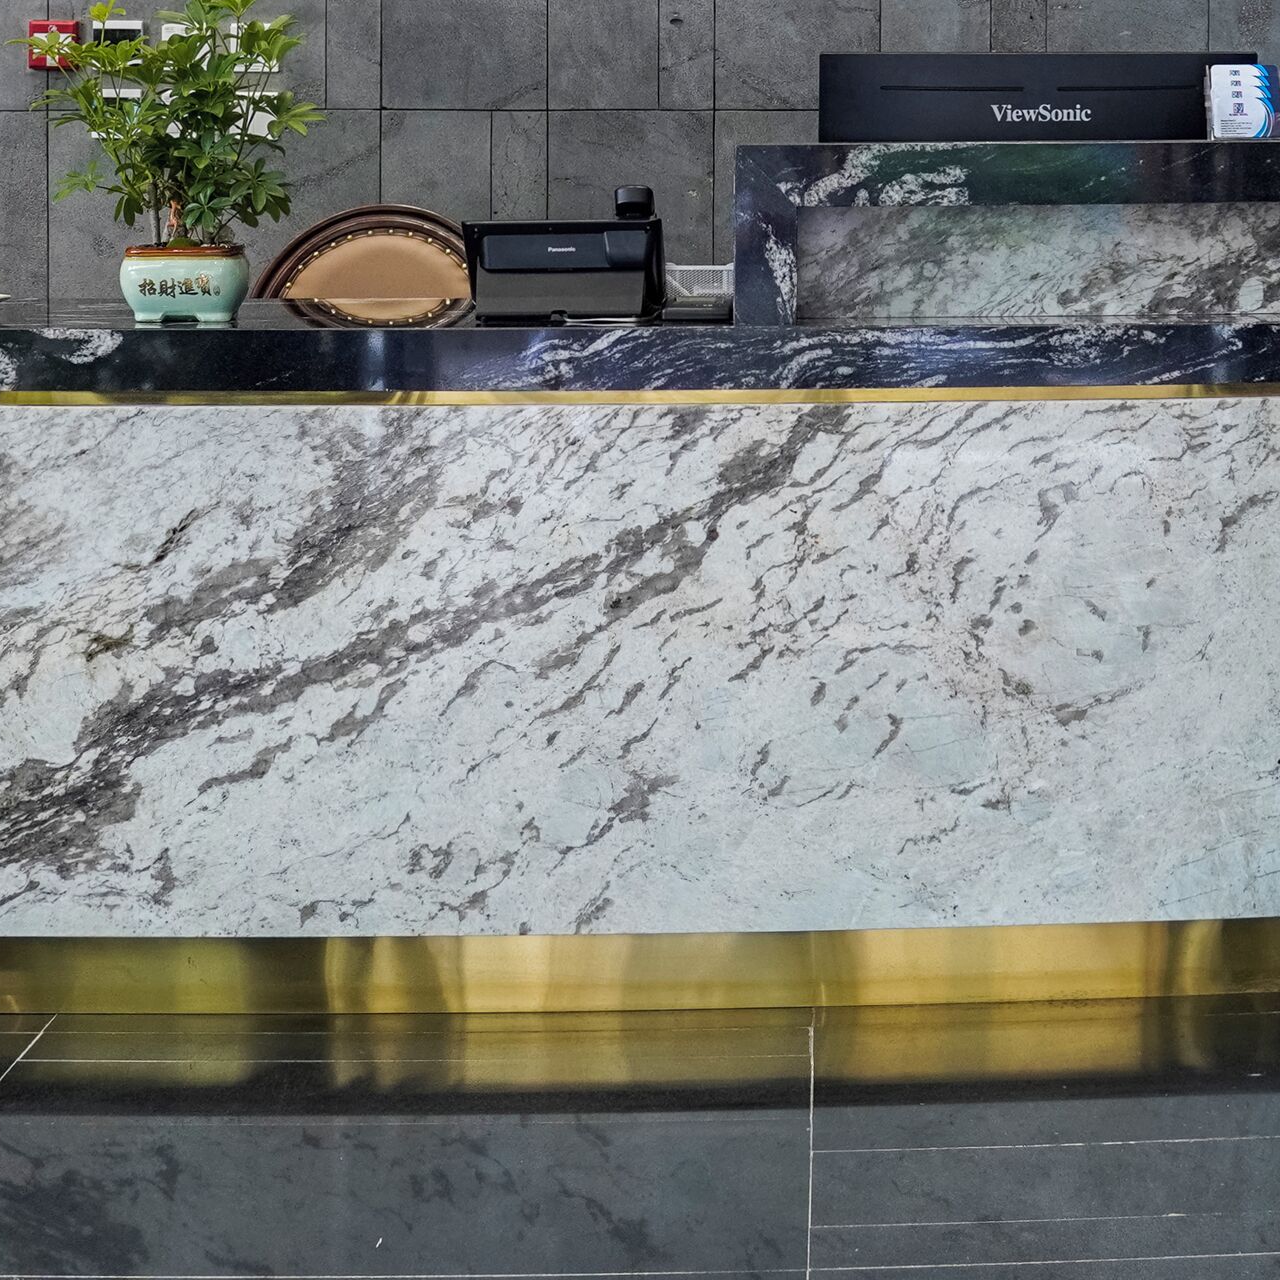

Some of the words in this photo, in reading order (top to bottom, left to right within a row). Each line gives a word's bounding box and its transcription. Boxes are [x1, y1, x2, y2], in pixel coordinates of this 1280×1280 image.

[990, 104, 1092, 122] ViewSonic
[138, 274, 212, 298] 招財進寶
